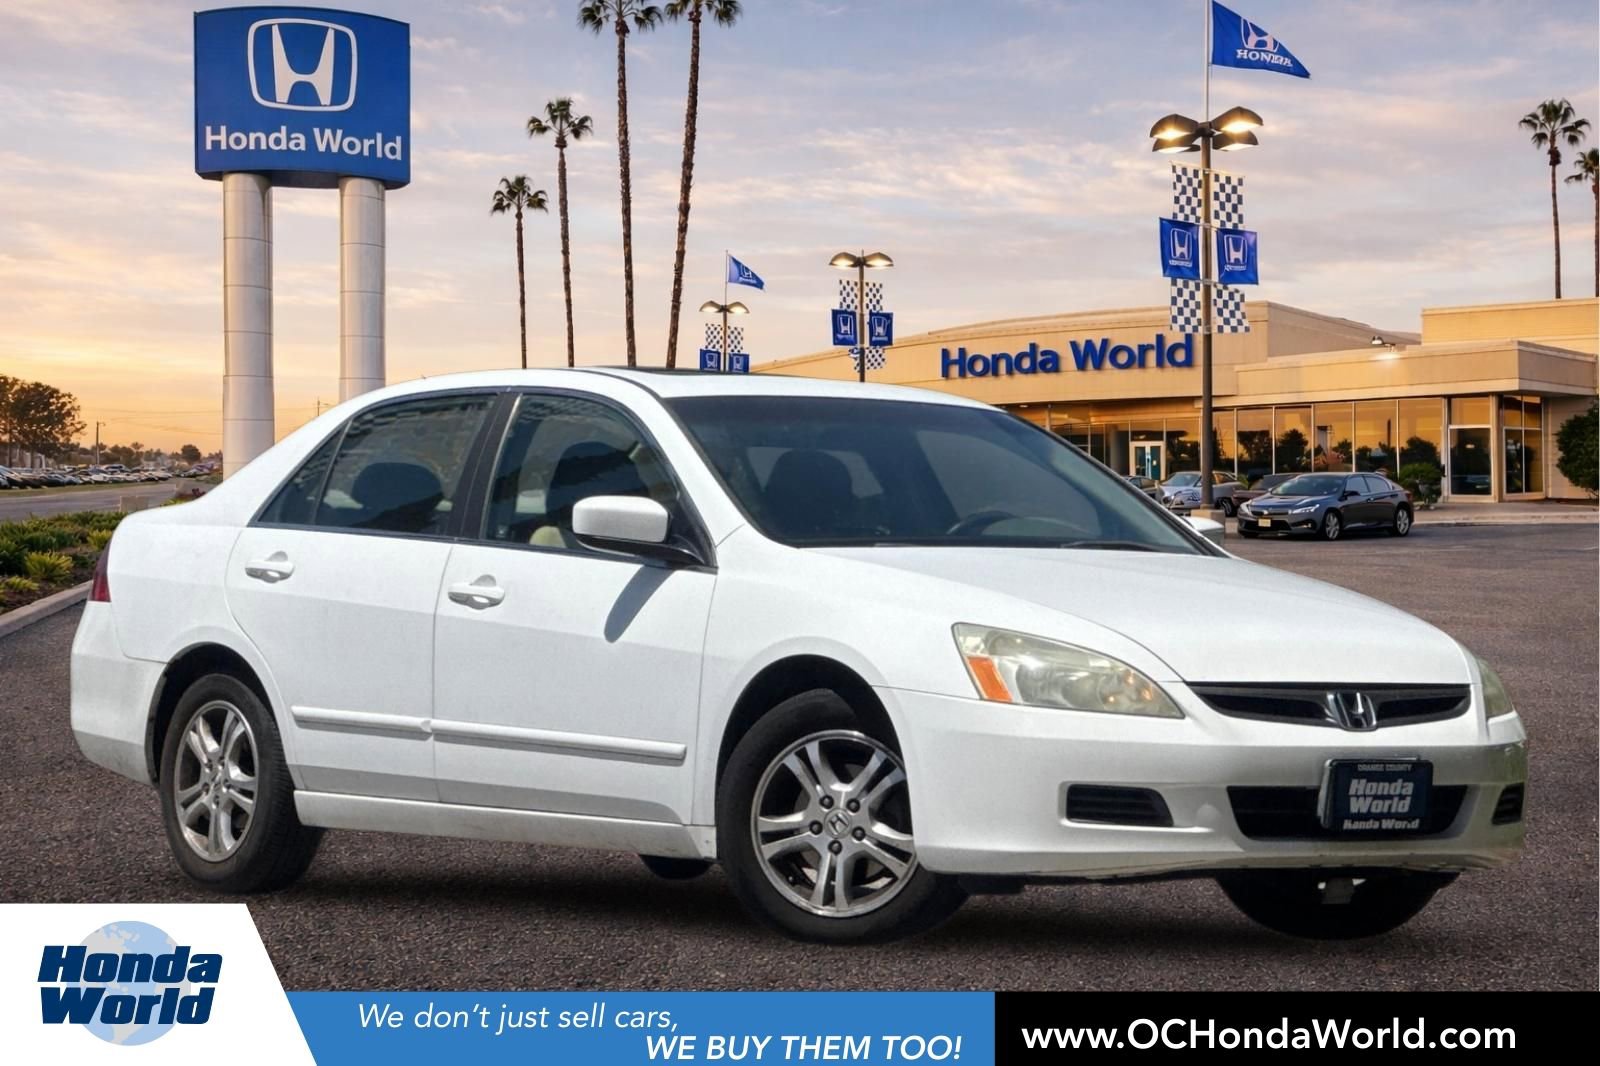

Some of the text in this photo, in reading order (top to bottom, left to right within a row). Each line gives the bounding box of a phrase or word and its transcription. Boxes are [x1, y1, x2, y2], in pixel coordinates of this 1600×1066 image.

[205, 125, 402, 161] Honda World
[941, 333, 1194, 378] Honda World
[1348, 778, 1414, 796] Honda
[1349, 796, 1412, 814] World
